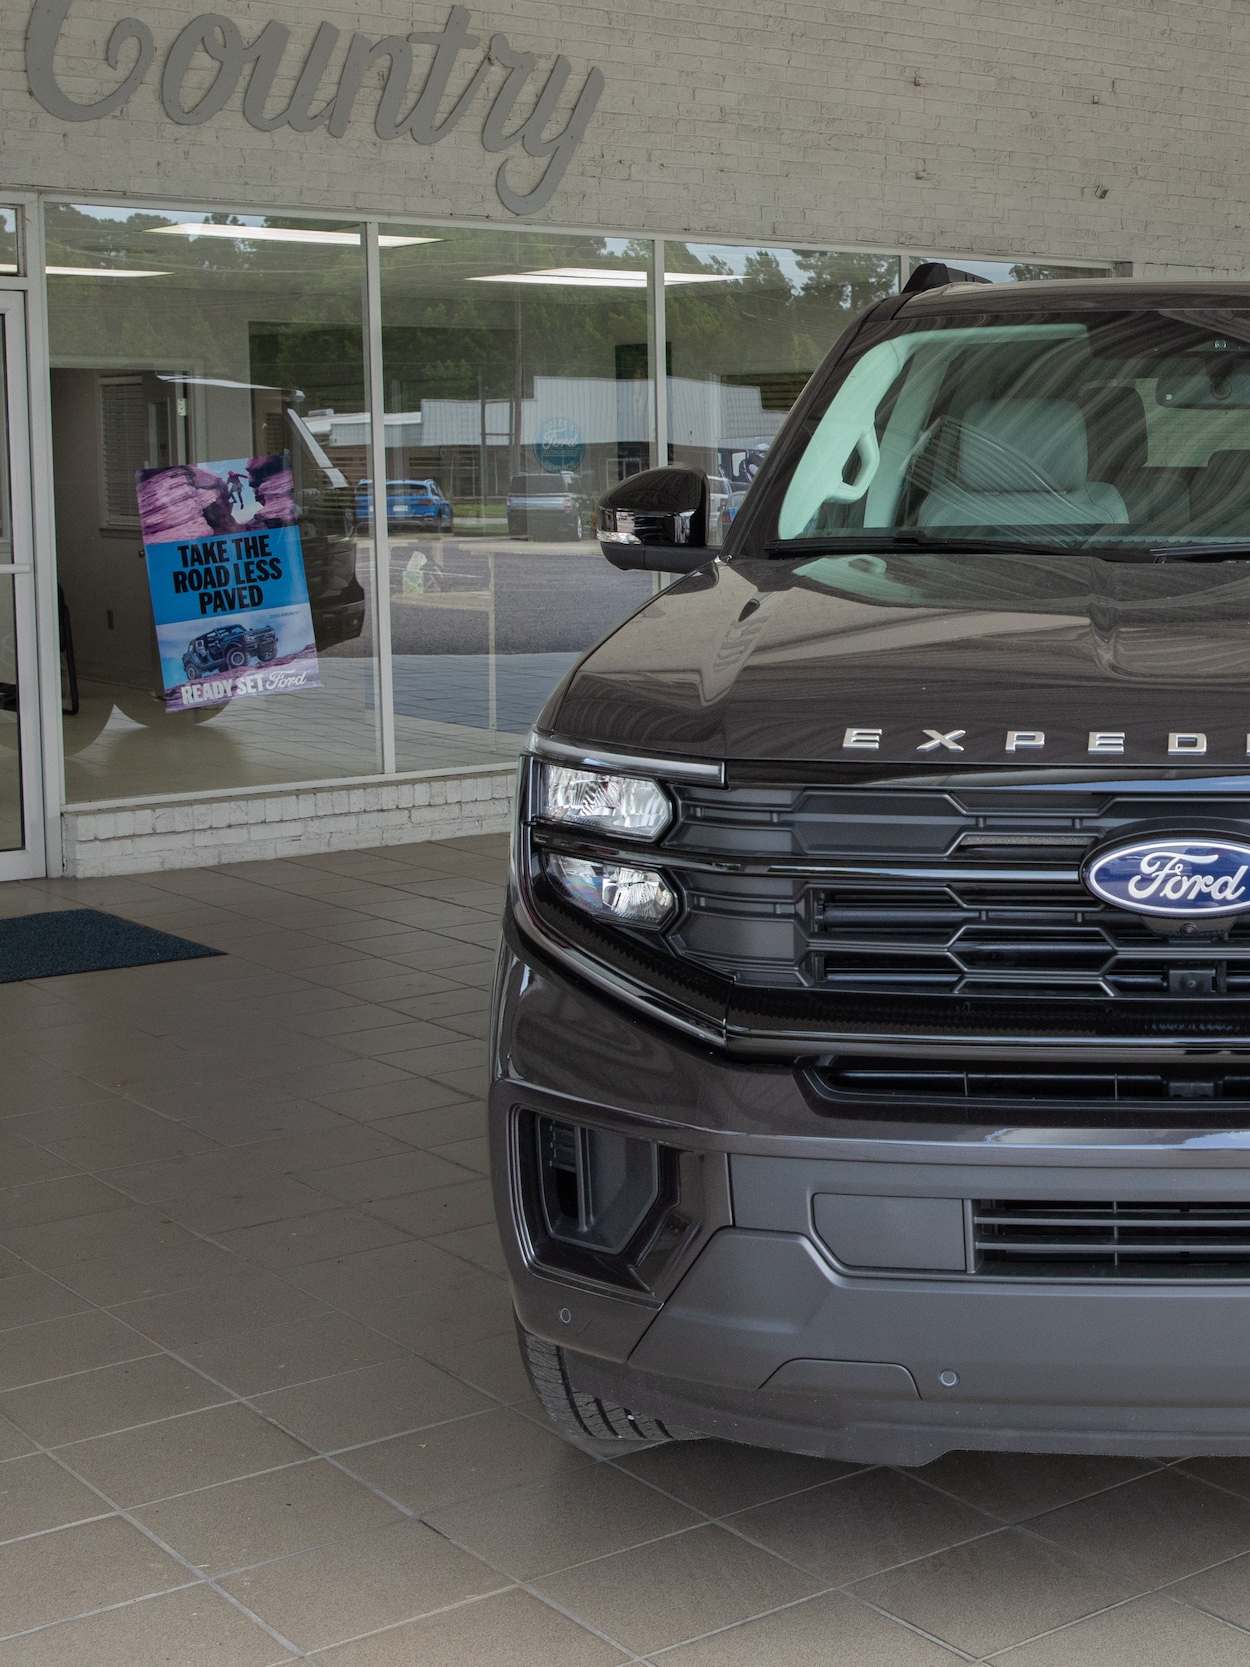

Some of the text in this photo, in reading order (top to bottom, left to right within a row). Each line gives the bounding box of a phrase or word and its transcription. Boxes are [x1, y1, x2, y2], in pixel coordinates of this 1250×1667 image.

[25, 0, 605, 215] Country
[542, 428, 578, 449] Ford
[177, 534, 272, 568] TAKE THE
[173, 557, 283, 594] ROAD LESS
[198, 585, 264, 615] PAVED
[181, 669, 307, 705] READY SET Ford
[1127, 851, 1246, 902] Ford
